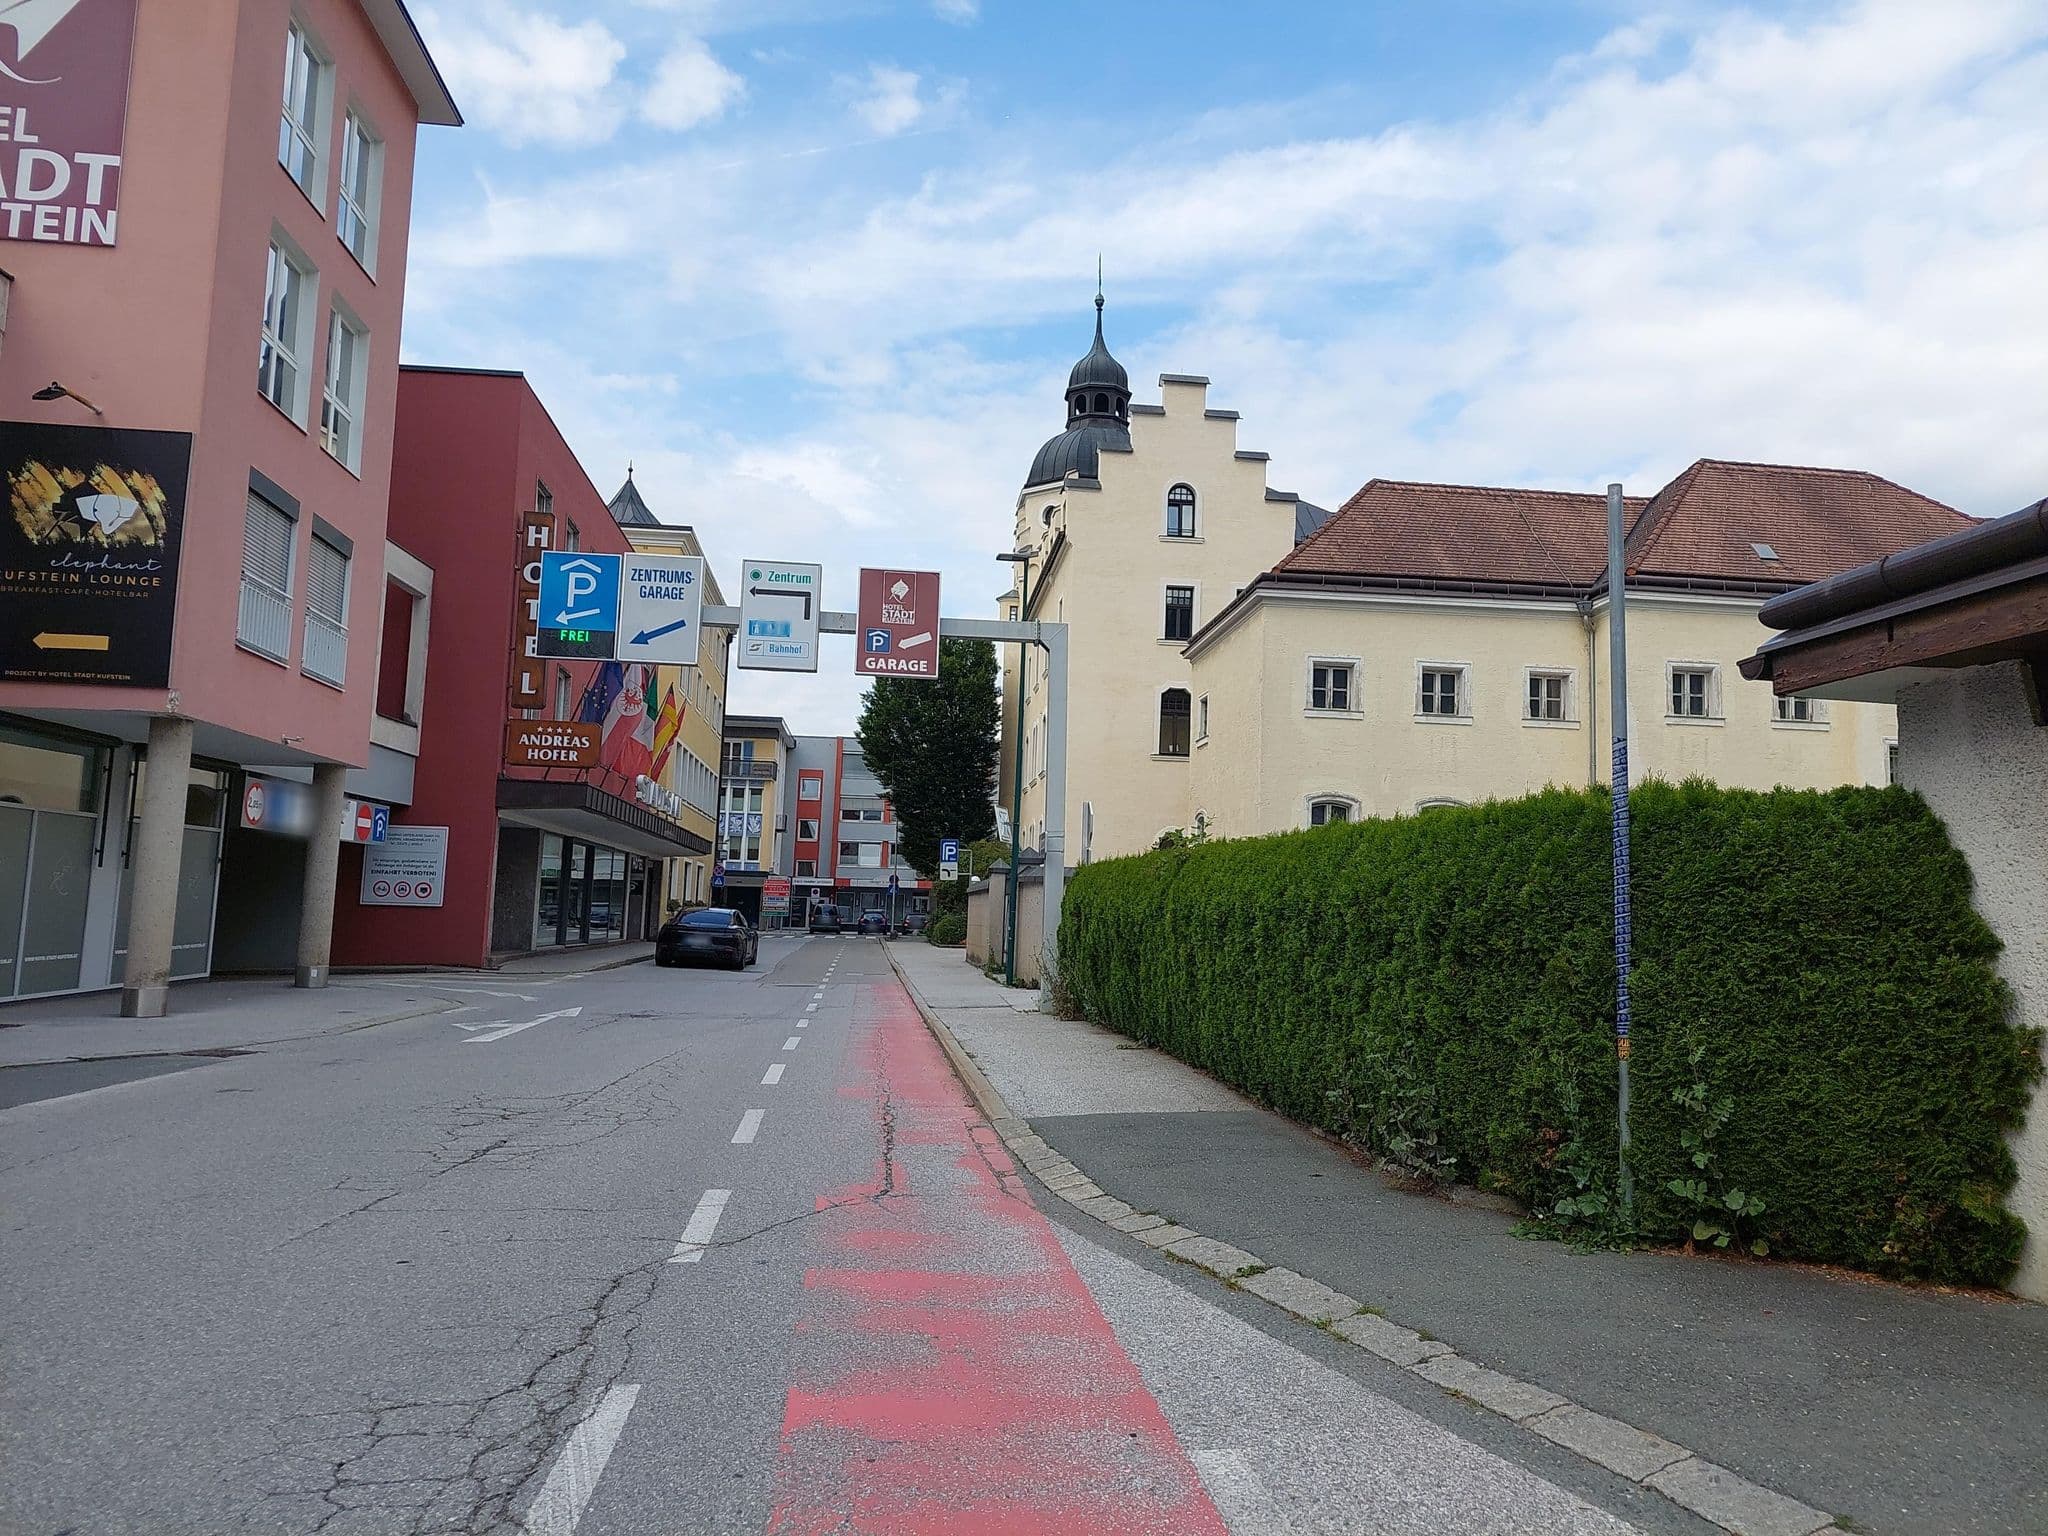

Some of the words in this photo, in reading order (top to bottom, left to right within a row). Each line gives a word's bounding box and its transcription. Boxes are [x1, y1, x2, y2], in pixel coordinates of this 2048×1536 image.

[1, 202, 117, 246] TEIN
[50, 552, 162, 573] elephant
[0, 570, 80, 582] UFSTEIN
[90, 574, 162, 587] LOUNGE
[630, 568, 696, 584] ZENTRUMS-
[768, 570, 812, 585] Zentrum
[639, 585, 685, 600] GARAGE
[883, 603, 904, 611] HOTEL
[883, 609, 915, 619] STADT
[560, 629, 589, 642] FREI
[768, 644, 802, 655] Bahnhof
[865, 657, 928, 672] GARAGE
[519, 733, 590, 748] ANDREAS
[527, 749, 578, 762] HOFER
